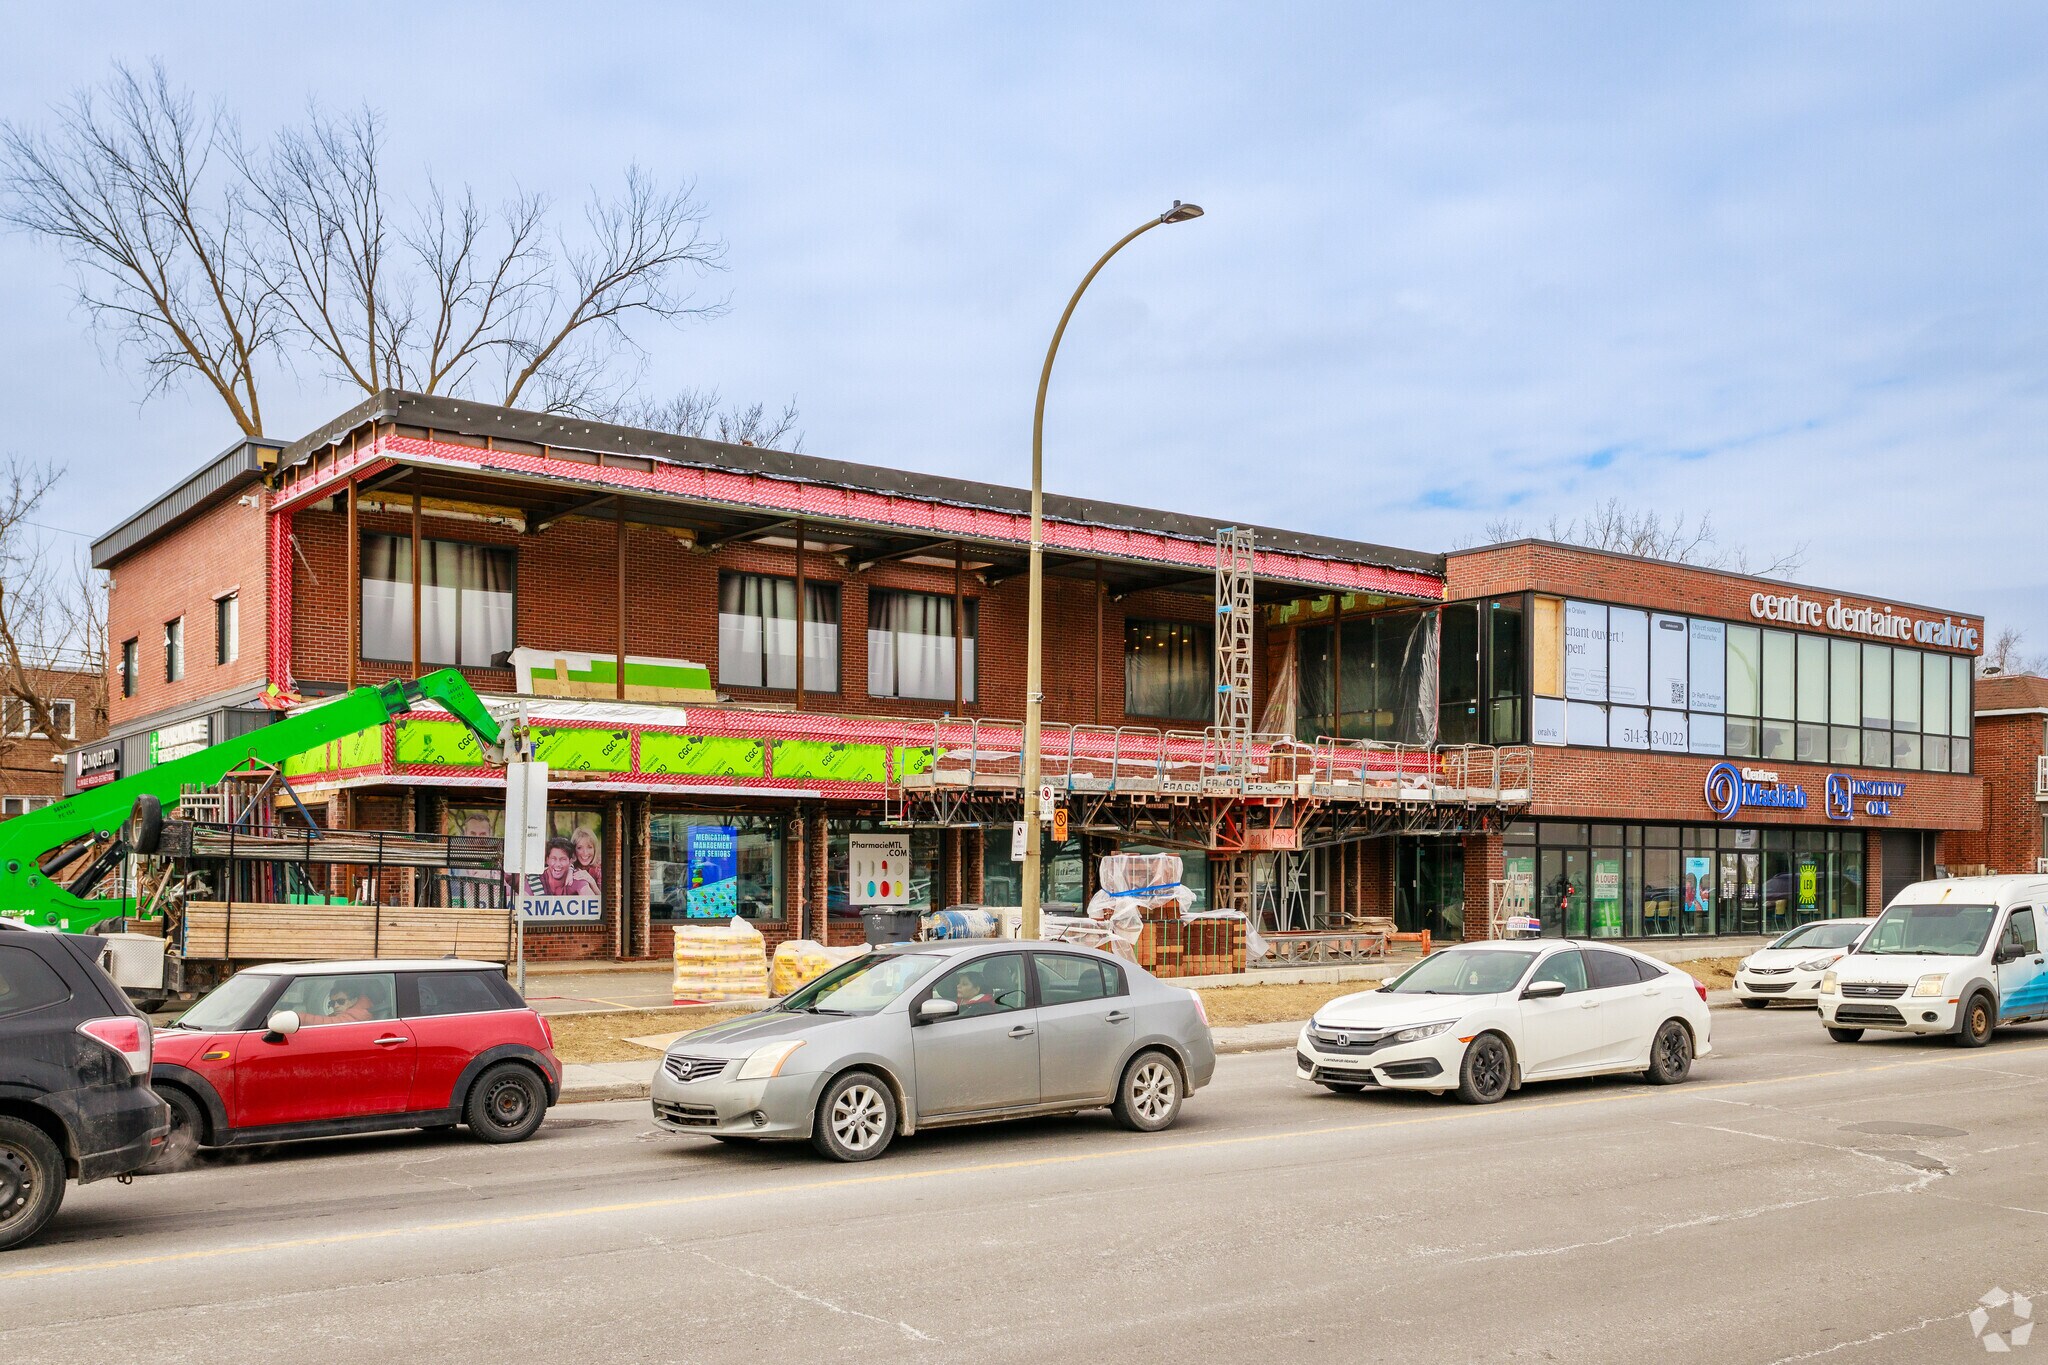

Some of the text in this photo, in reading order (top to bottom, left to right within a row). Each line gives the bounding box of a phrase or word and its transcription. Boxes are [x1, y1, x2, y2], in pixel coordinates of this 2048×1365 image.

[1750, 592, 1978, 650] centre dentaire oralvie
[1565, 642, 1586, 656] pen!
[1538, 728, 1558, 737] oralvie
[1624, 728, 1684, 746] 514-313-0122
[458, 734, 474, 750] CGC
[602, 740, 617, 756] CGC
[678, 744, 692, 759] CGC
[745, 748, 758, 762] CGC
[82, 751, 102, 769] CLINIQUE
[822, 752, 835, 766] CGC
[914, 756, 926, 770] CGC
[1742, 767, 1778, 782] Centres
[1163, 782, 1198, 792] FRACO
[1852, 780, 1906, 797] INSTITUT
[1742, 782, 1807, 808] Masliah
[1866, 800, 1891, 816] ORL
[693, 842, 732, 850] MANAGEMENT
[851, 841, 902, 849] PharmacieMTL
[1250, 834, 1268, 844] 20 K
[1276, 834, 1292, 845] 20 K
[707, 850, 731, 858] SENIORS
[1600, 874, 1618, 883] LOUER
[1804, 879, 1813, 890] LED
